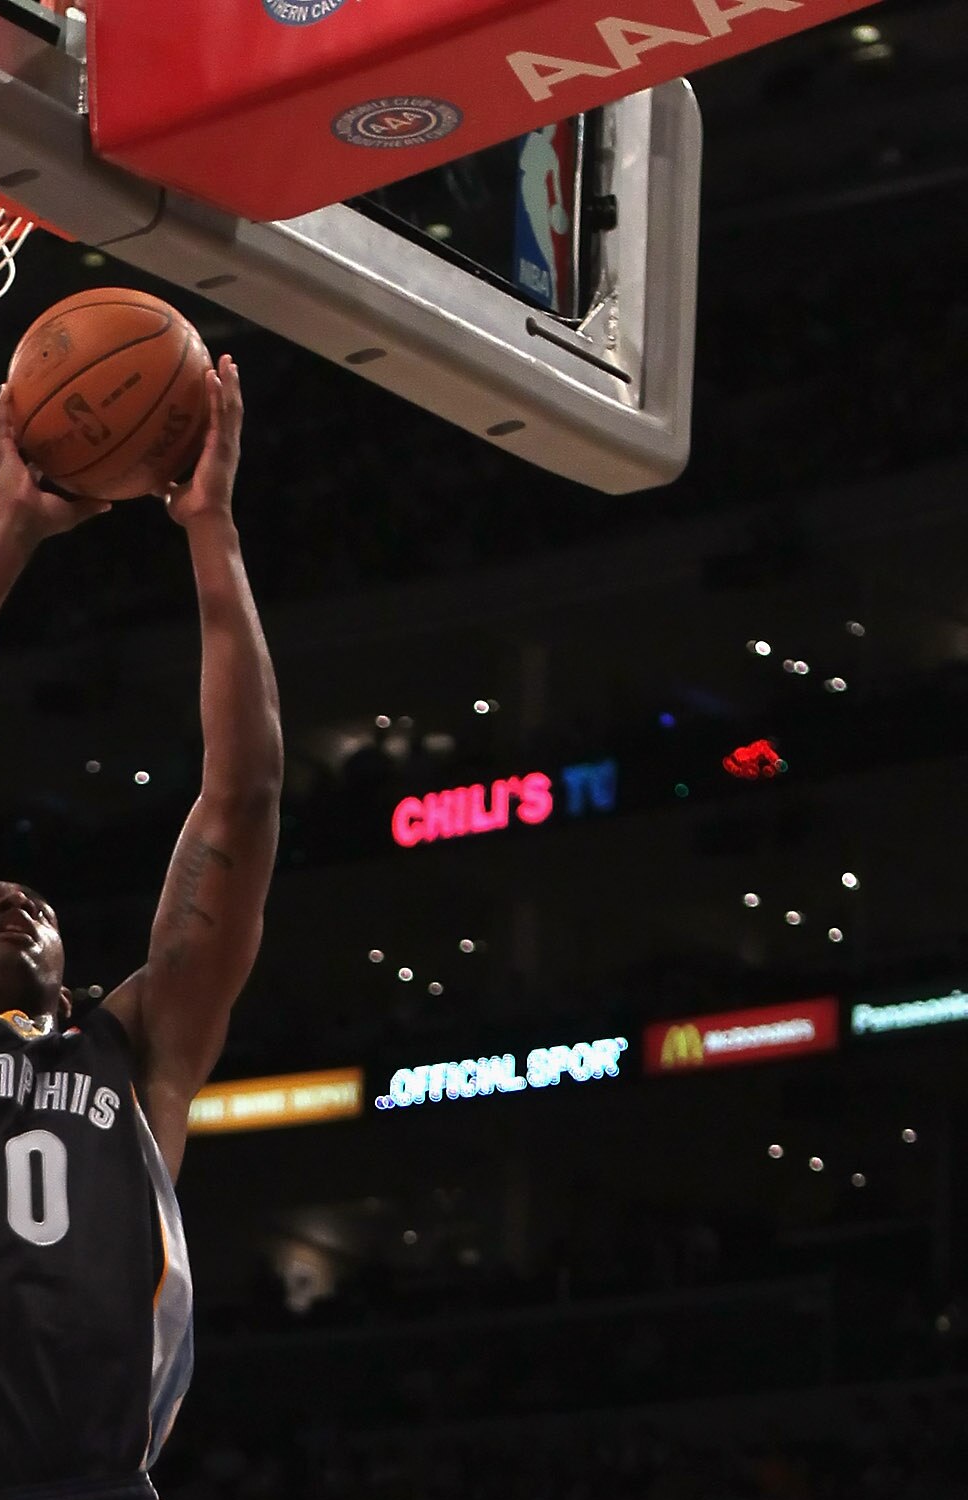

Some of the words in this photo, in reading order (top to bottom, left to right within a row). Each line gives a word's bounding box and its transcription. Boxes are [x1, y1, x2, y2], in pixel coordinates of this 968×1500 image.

[506, 0, 804, 102] AAA
[370, 111, 422, 134] AAA
[392, 772, 553, 848] CHILI'S
